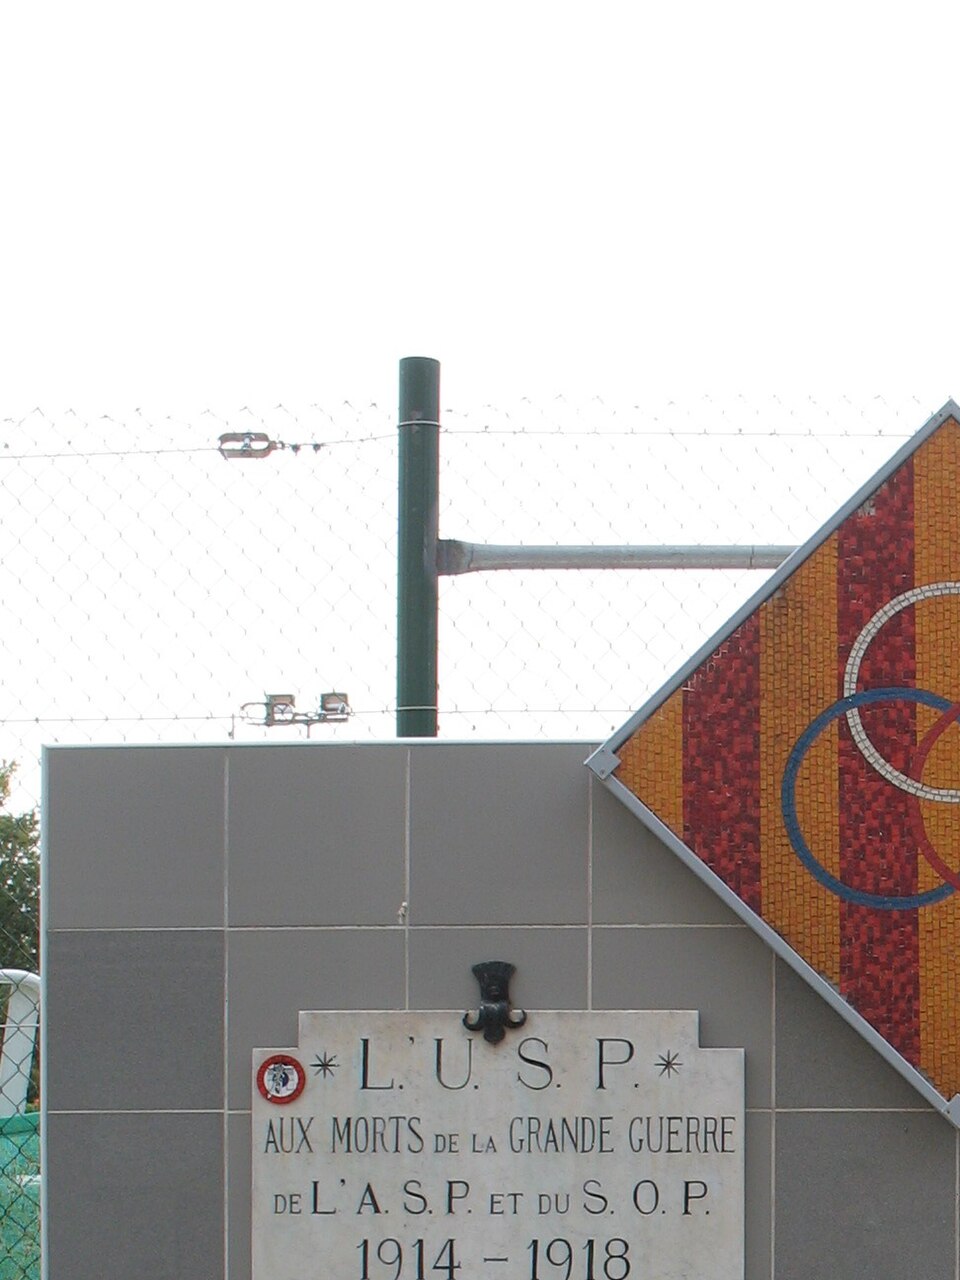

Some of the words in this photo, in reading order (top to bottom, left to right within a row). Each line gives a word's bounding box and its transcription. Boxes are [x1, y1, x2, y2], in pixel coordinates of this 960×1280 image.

[264, 1117, 314, 1154] AUX
[331, 1117, 424, 1154] MORTS
[510, 1117, 615, 1154] GRANDE
[629, 1117, 735, 1154] GUERRE
